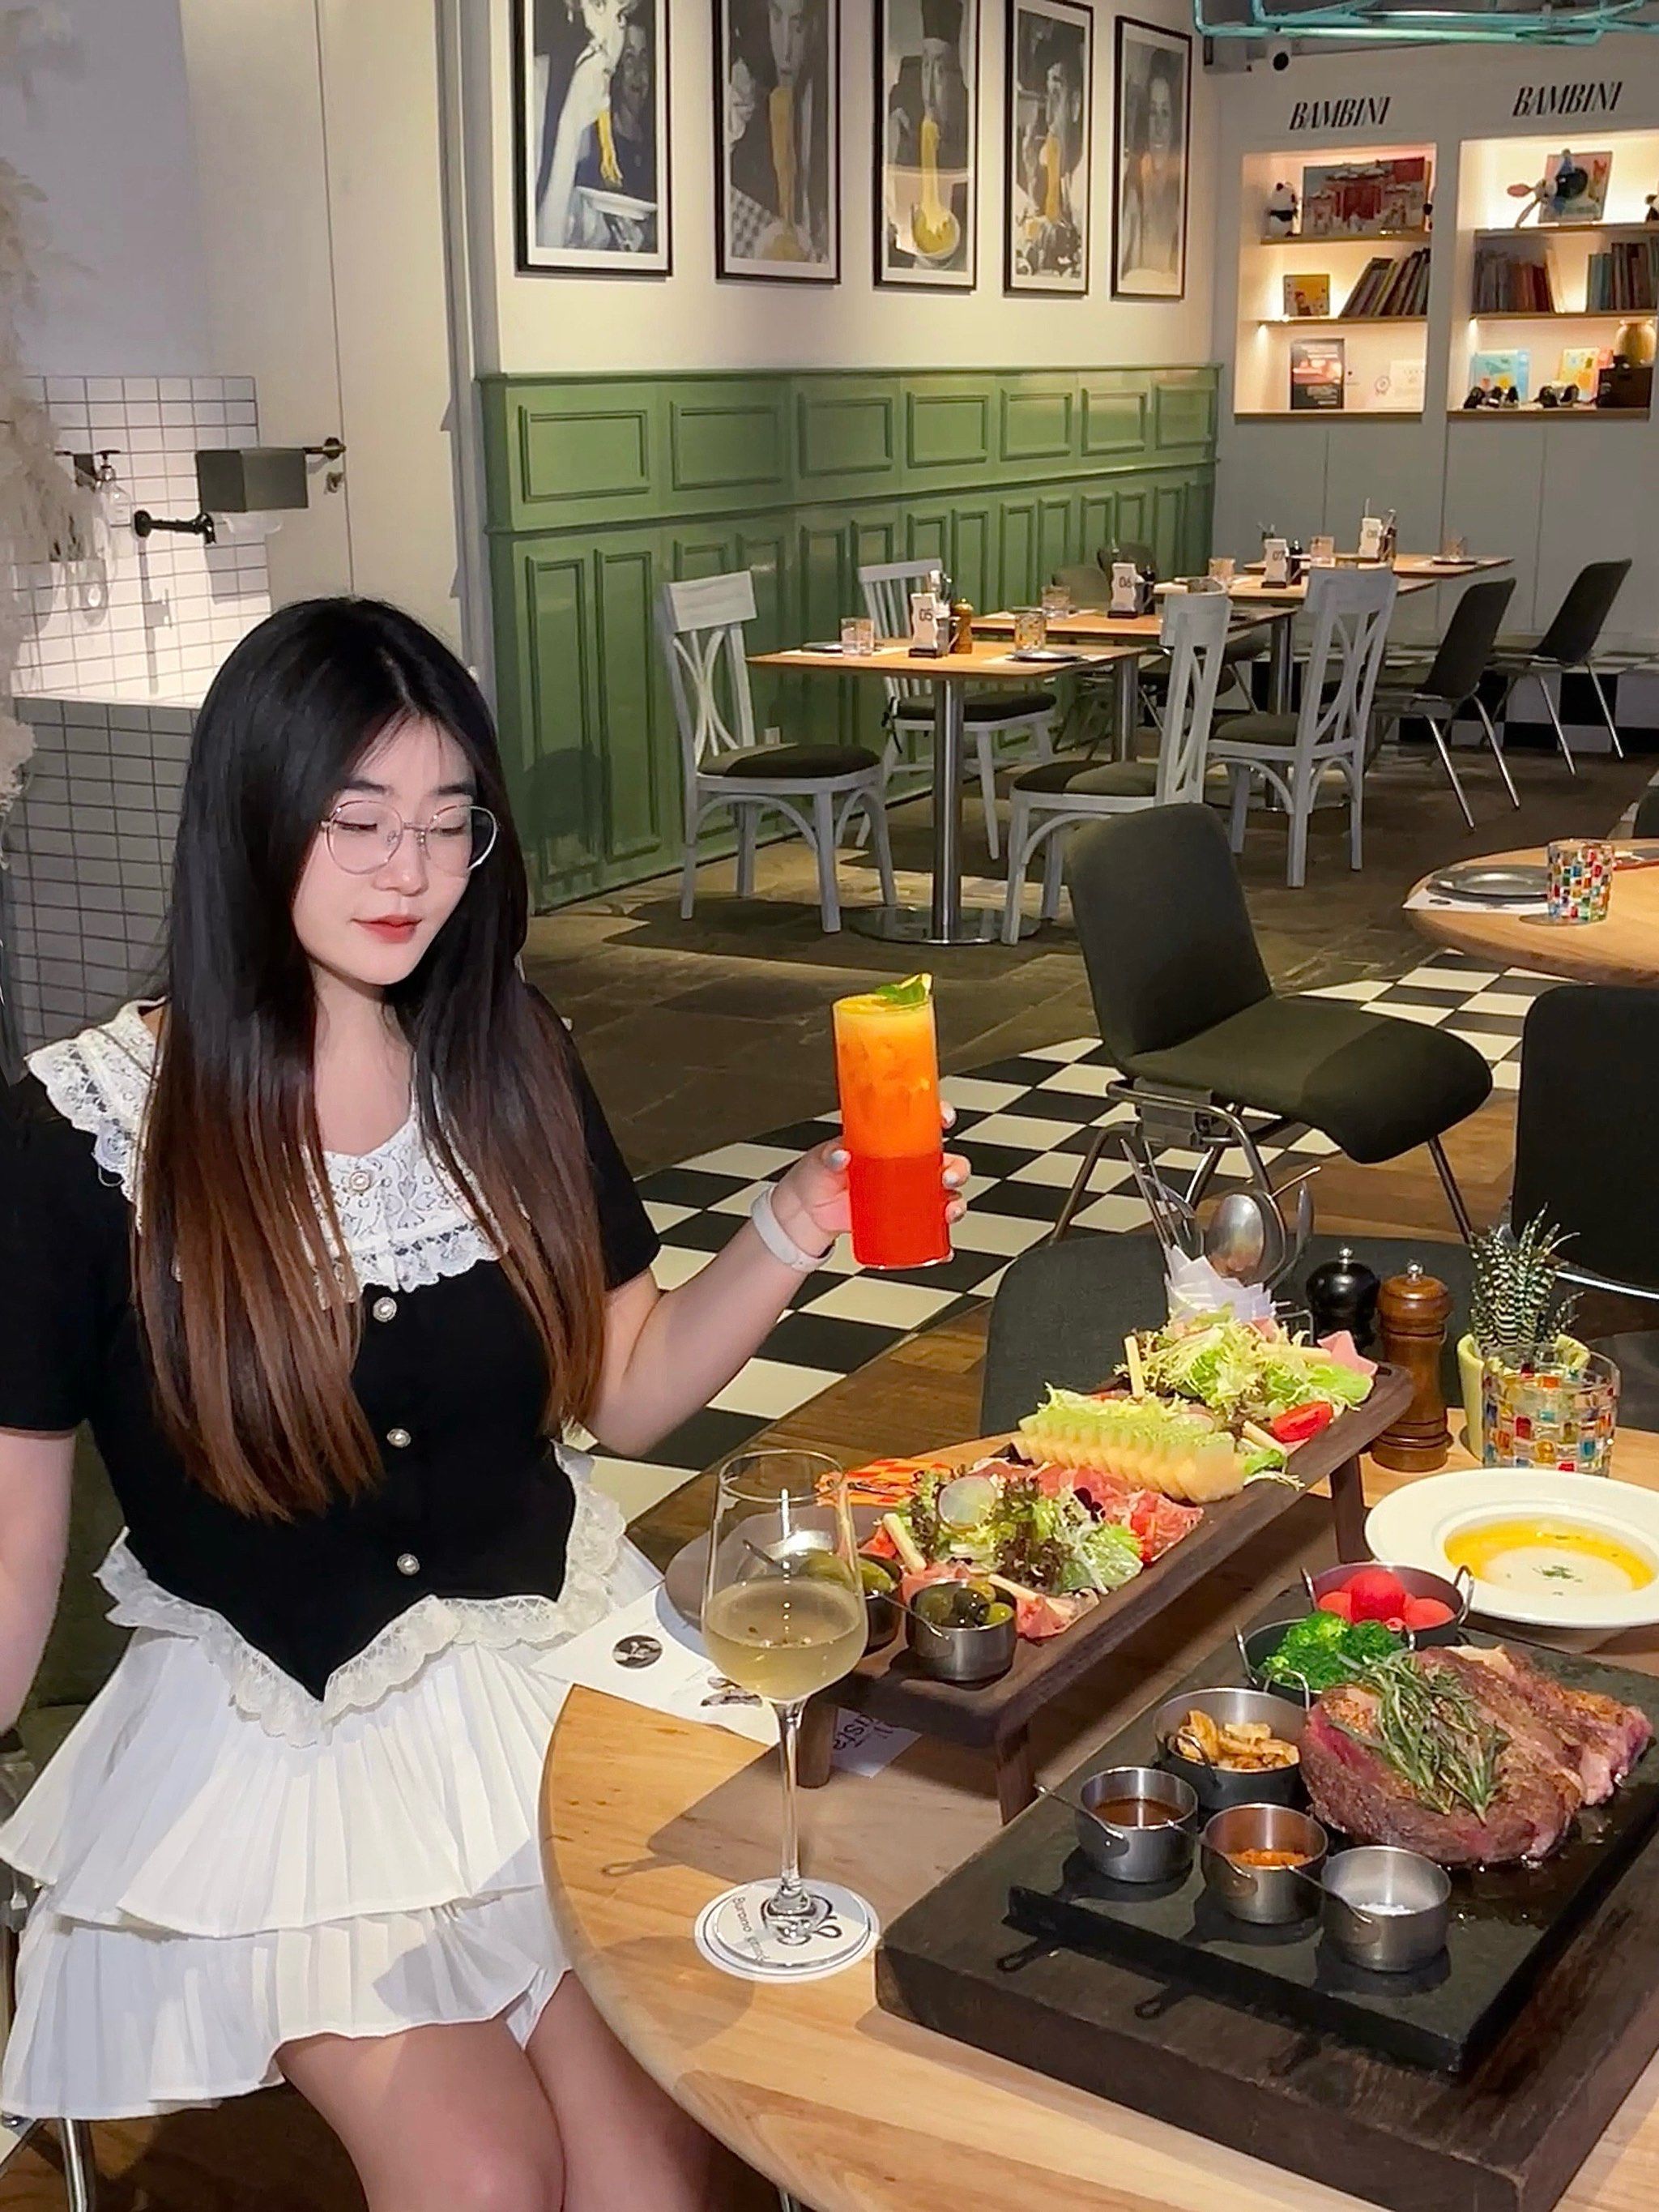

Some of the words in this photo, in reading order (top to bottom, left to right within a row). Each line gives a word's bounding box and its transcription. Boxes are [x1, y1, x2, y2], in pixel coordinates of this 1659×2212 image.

[1289, 96, 1391, 130] BAMBINI
[1508, 81, 1623, 117] BAMBINI
[919, 608, 933, 621] 05
